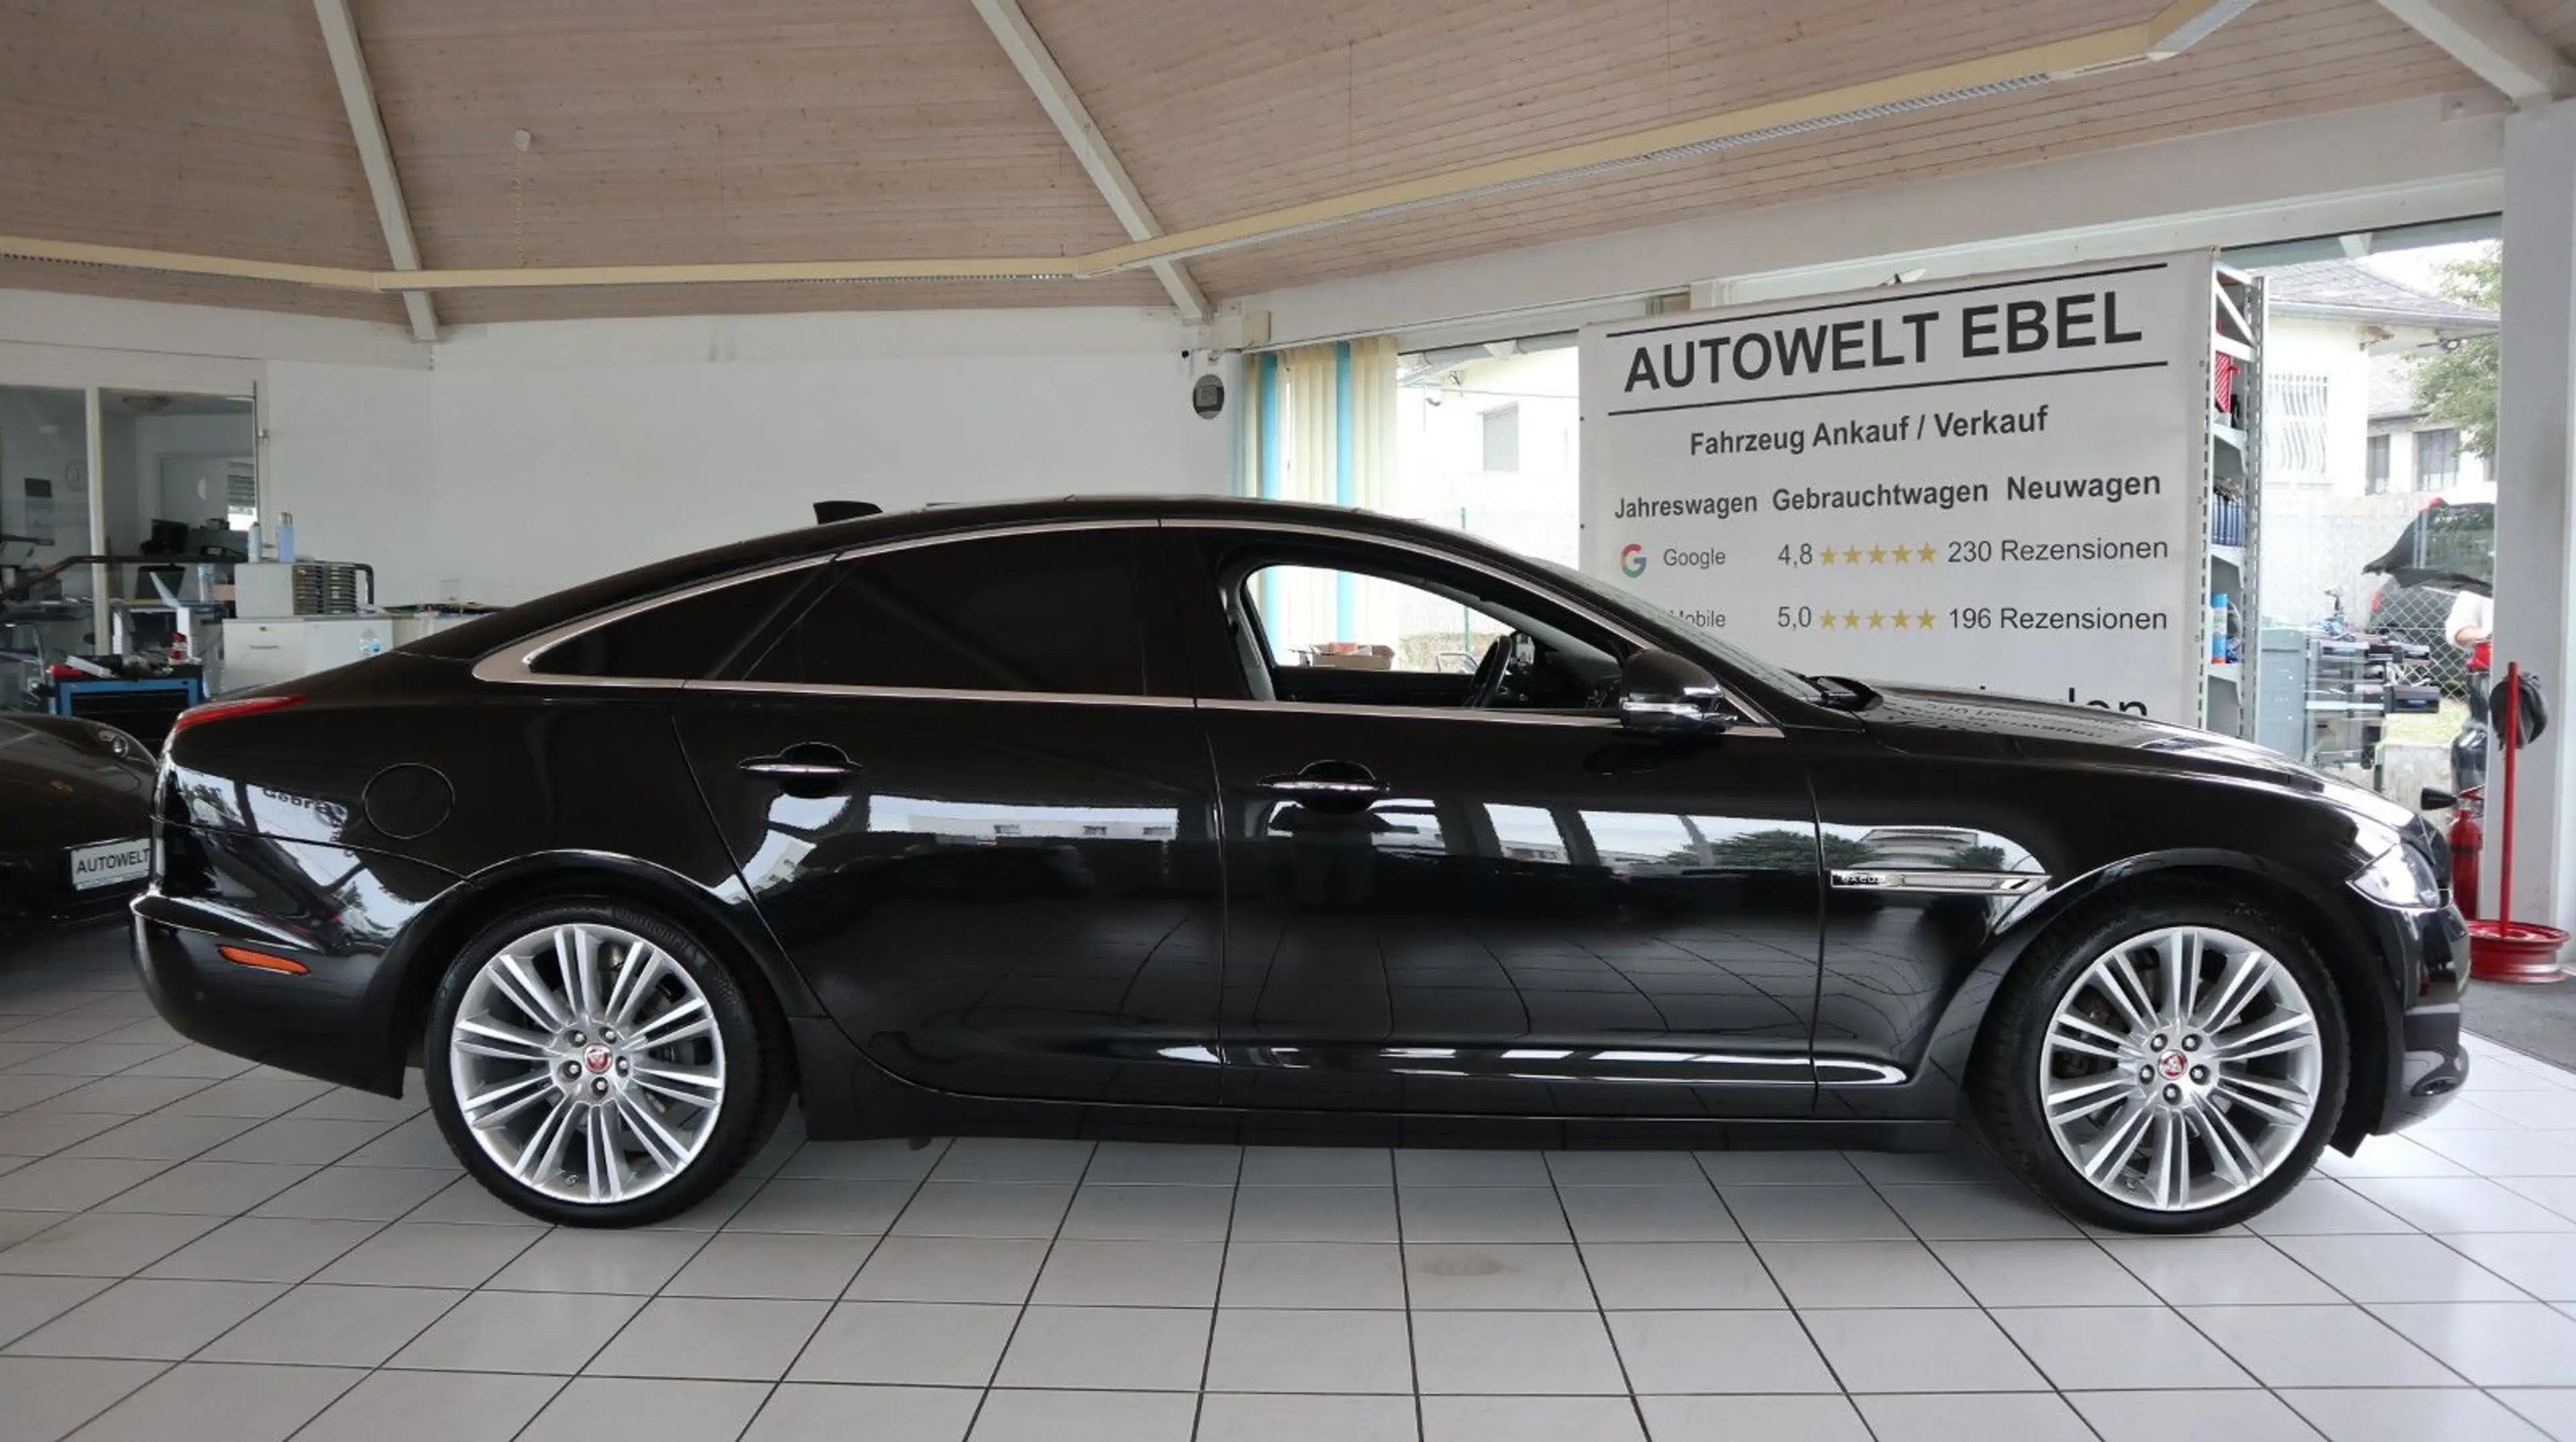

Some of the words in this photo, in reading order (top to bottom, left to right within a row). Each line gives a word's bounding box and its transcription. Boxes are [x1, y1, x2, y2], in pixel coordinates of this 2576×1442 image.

[1624, 311, 1939, 393] AUTOWELT
[1962, 290, 2143, 359] EBEL
[1690, 421, 1805, 456] Fahrzeug
[1812, 415, 1910, 447] Ankauf
[1917, 414, 1925, 441] /
[1933, 404, 2049, 438] Verkauf
[1615, 490, 1758, 520] Jahreswagen
[1772, 482, 1989, 511] Gebrauchtwagen
[2007, 472, 2161, 504] Neuwagen
[1663, 547, 1726, 570] Google
[1778, 543, 1813, 567] 4,8
[1947, 540, 1992, 563] 230
[2001, 539, 2169, 562] Rezensionen
[1778, 606, 1813, 630] 5,0
[1949, 607, 1992, 629] 196
[2000, 606, 2167, 630] Rezensionen
[76, 848, 150, 874] AUTOWELT
